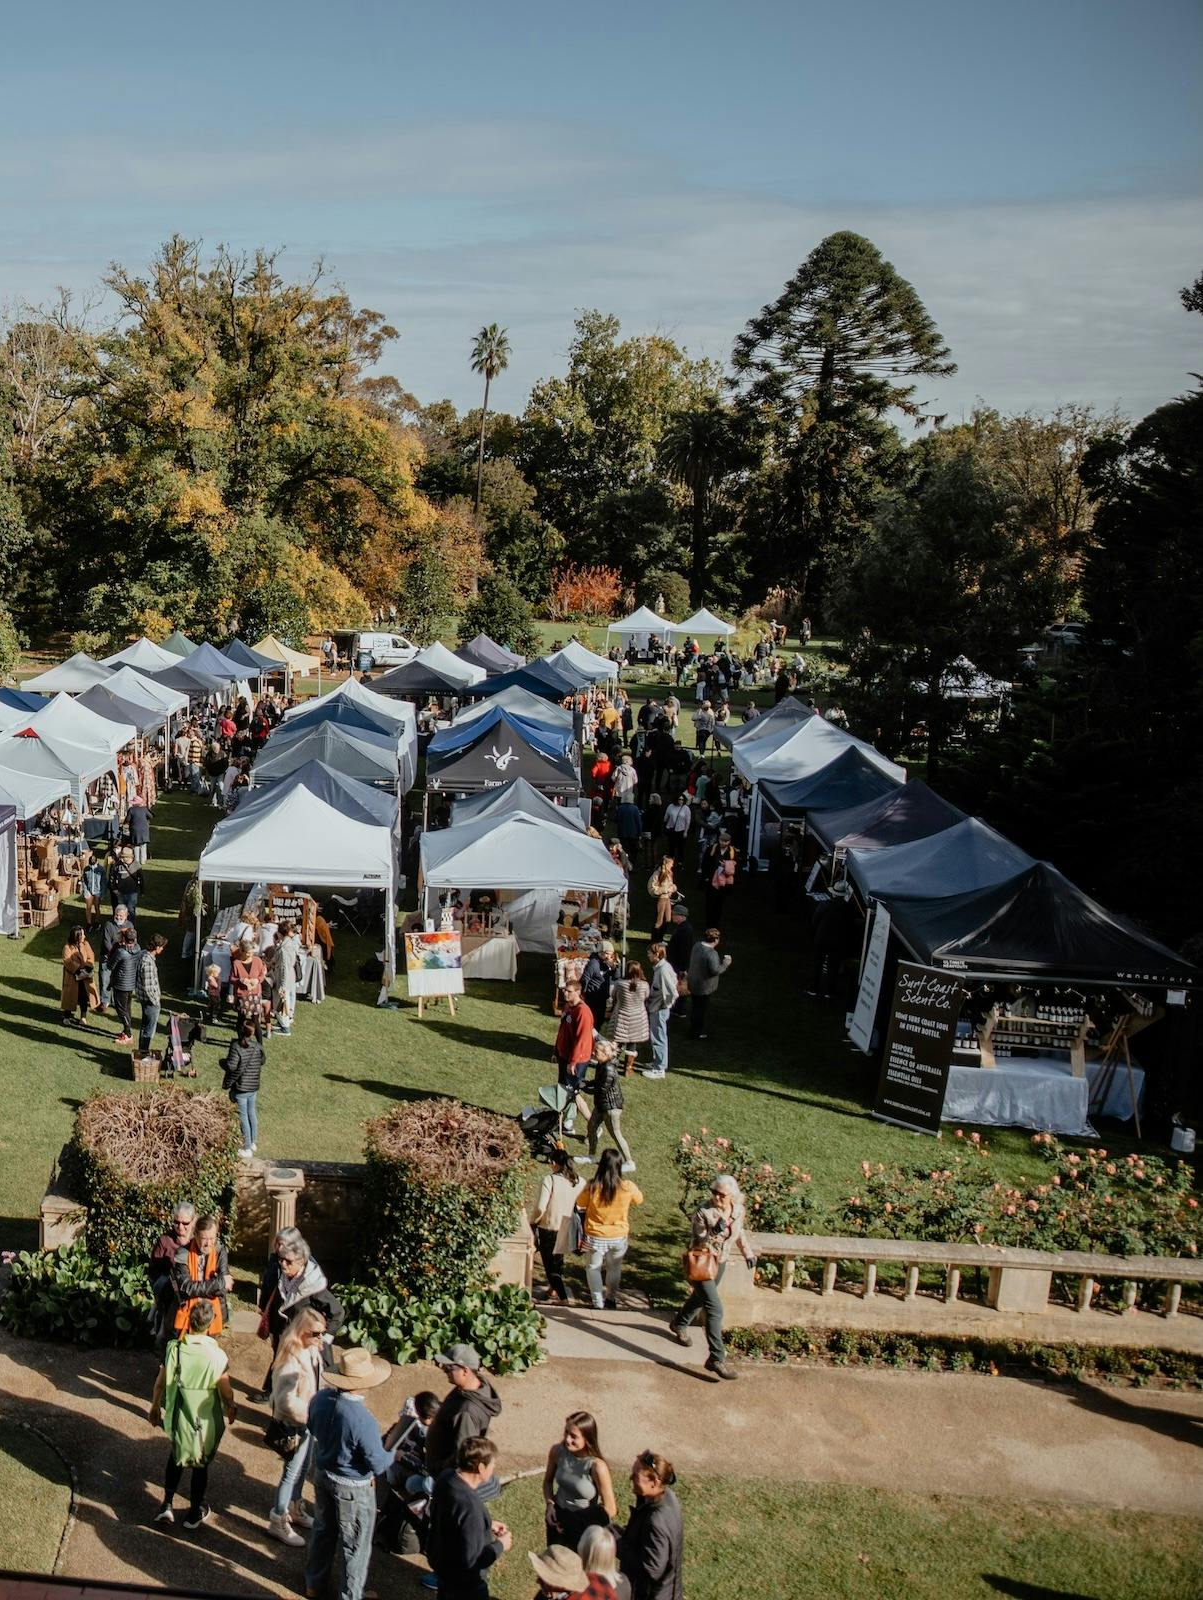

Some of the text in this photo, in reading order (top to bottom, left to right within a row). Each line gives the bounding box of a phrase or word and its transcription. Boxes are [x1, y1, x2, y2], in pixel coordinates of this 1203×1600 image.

[898, 973, 927, 996] Surf
[927, 978, 959, 994] Coast
[901, 989, 951, 1009] Scent Co.
